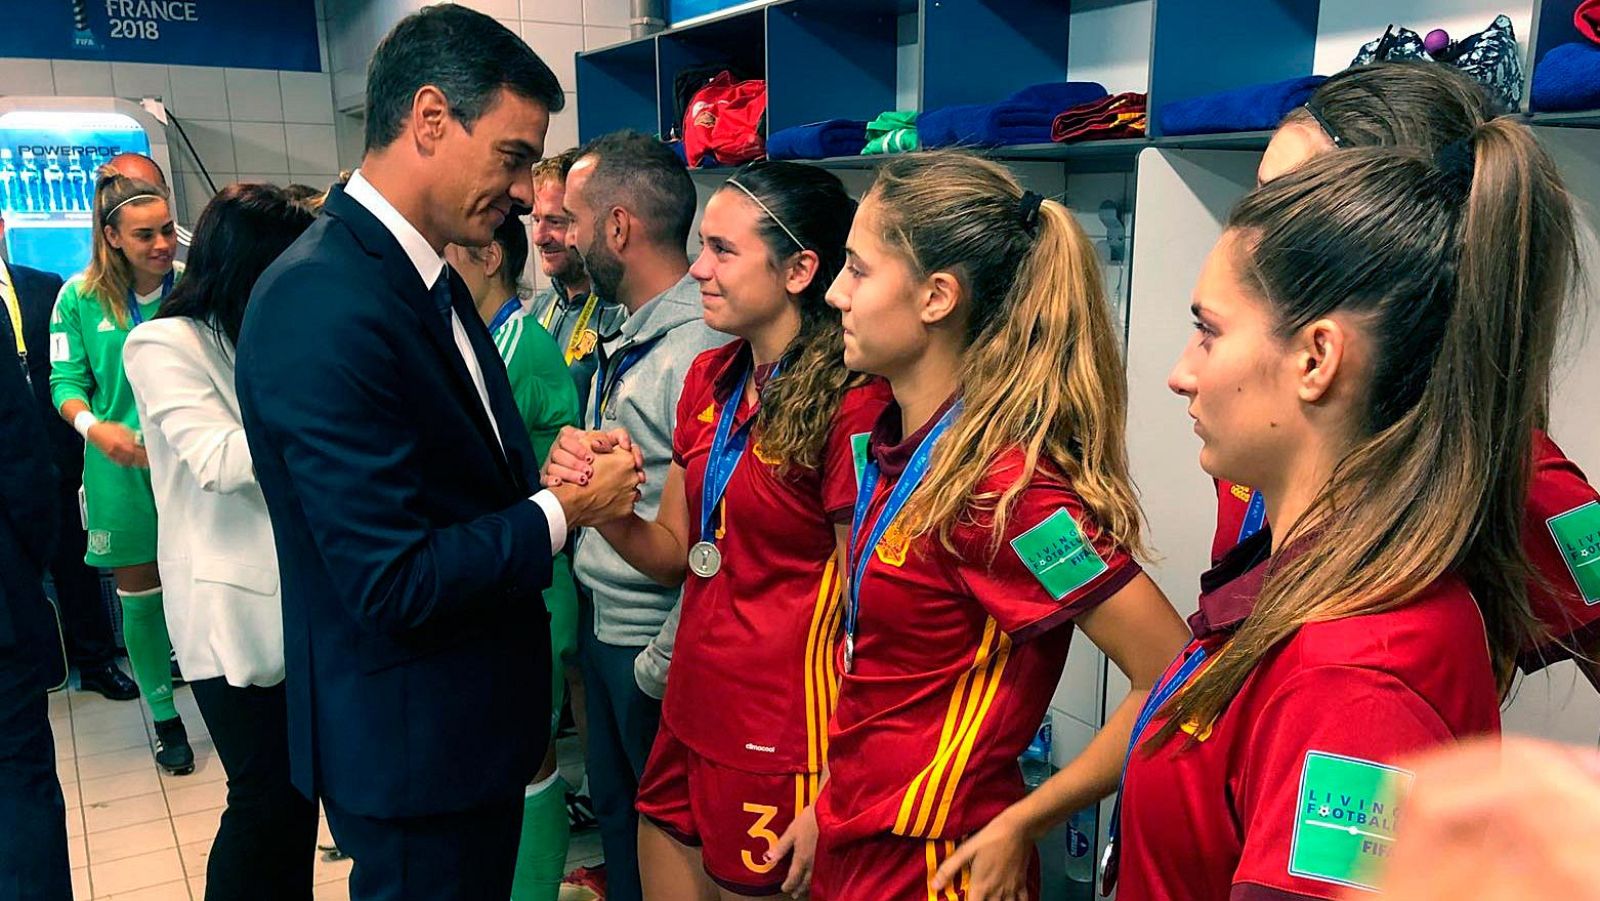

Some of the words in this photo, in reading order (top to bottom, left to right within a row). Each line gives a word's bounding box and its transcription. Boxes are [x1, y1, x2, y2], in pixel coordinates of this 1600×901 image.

[106, 0, 198, 21] FRANCE
[109, 19, 159, 40] 2018
[18, 145, 121, 157] POWERADE
[1028, 529, 1077, 563] LIVING
[1070, 549, 1091, 566] FIFA
[741, 802, 779, 874] 3
[1362, 840, 1394, 857] FIF
